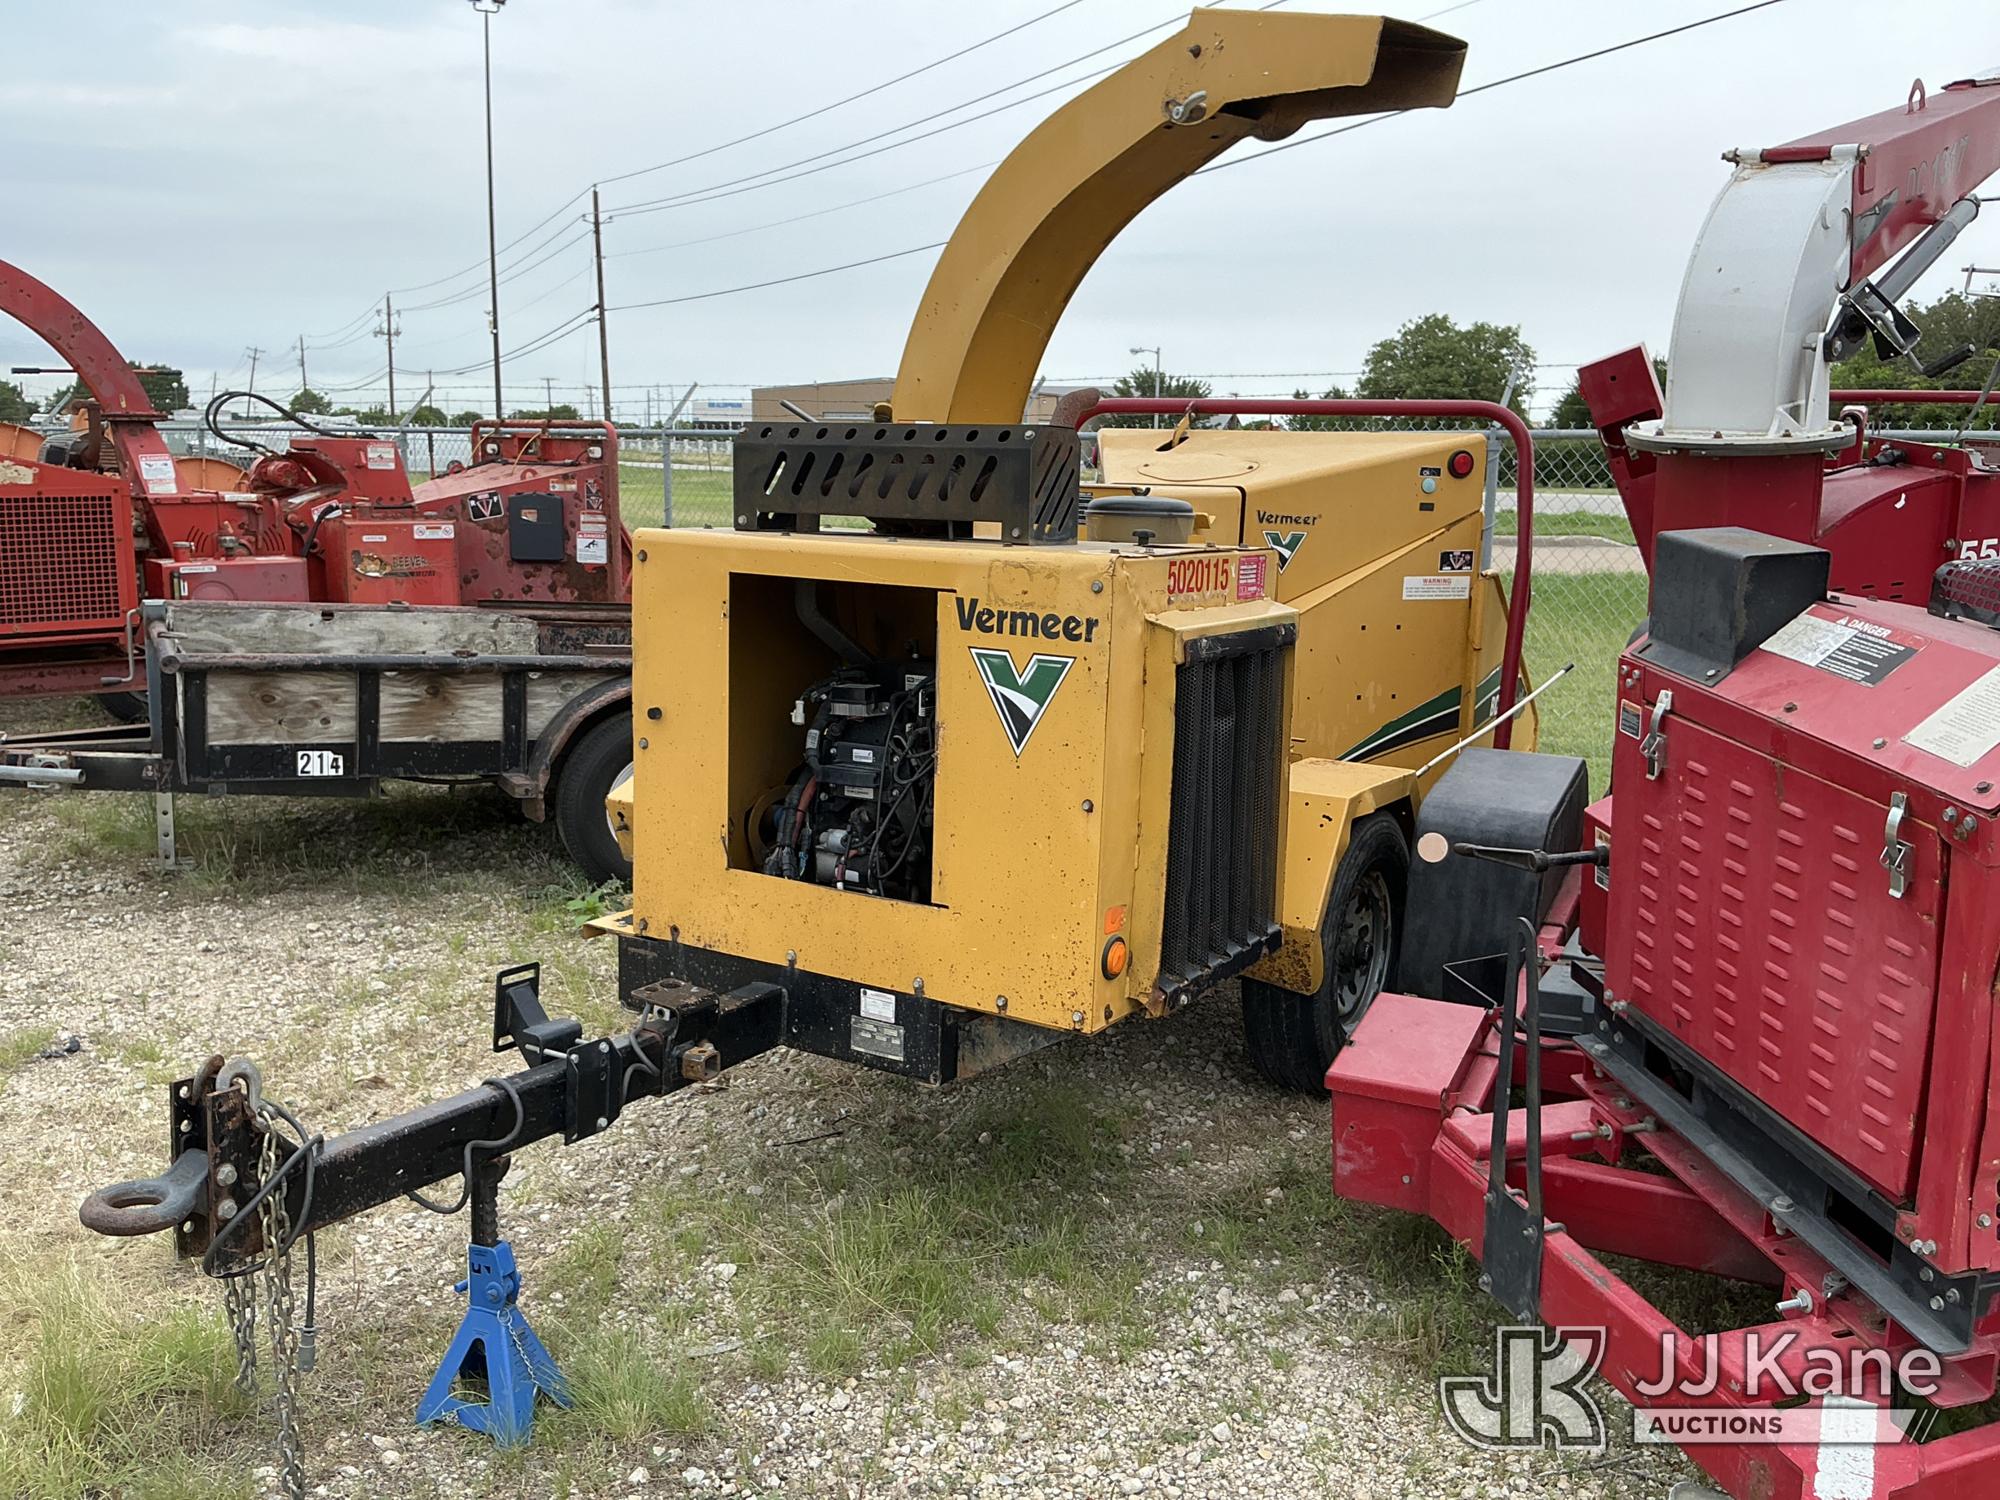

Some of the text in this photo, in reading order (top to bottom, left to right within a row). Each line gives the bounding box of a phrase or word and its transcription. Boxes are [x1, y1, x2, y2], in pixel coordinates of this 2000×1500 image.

[1256, 510, 1318, 526] Vermeer
[1960, 538, 2000, 562] 55
[1167, 558, 1229, 595] 5020115
[1422, 577, 1452, 585] WARNING
[955, 597, 1099, 643] Vermeer
[1847, 618, 1893, 639] DANGER
[299, 752, 341, 775] 214
